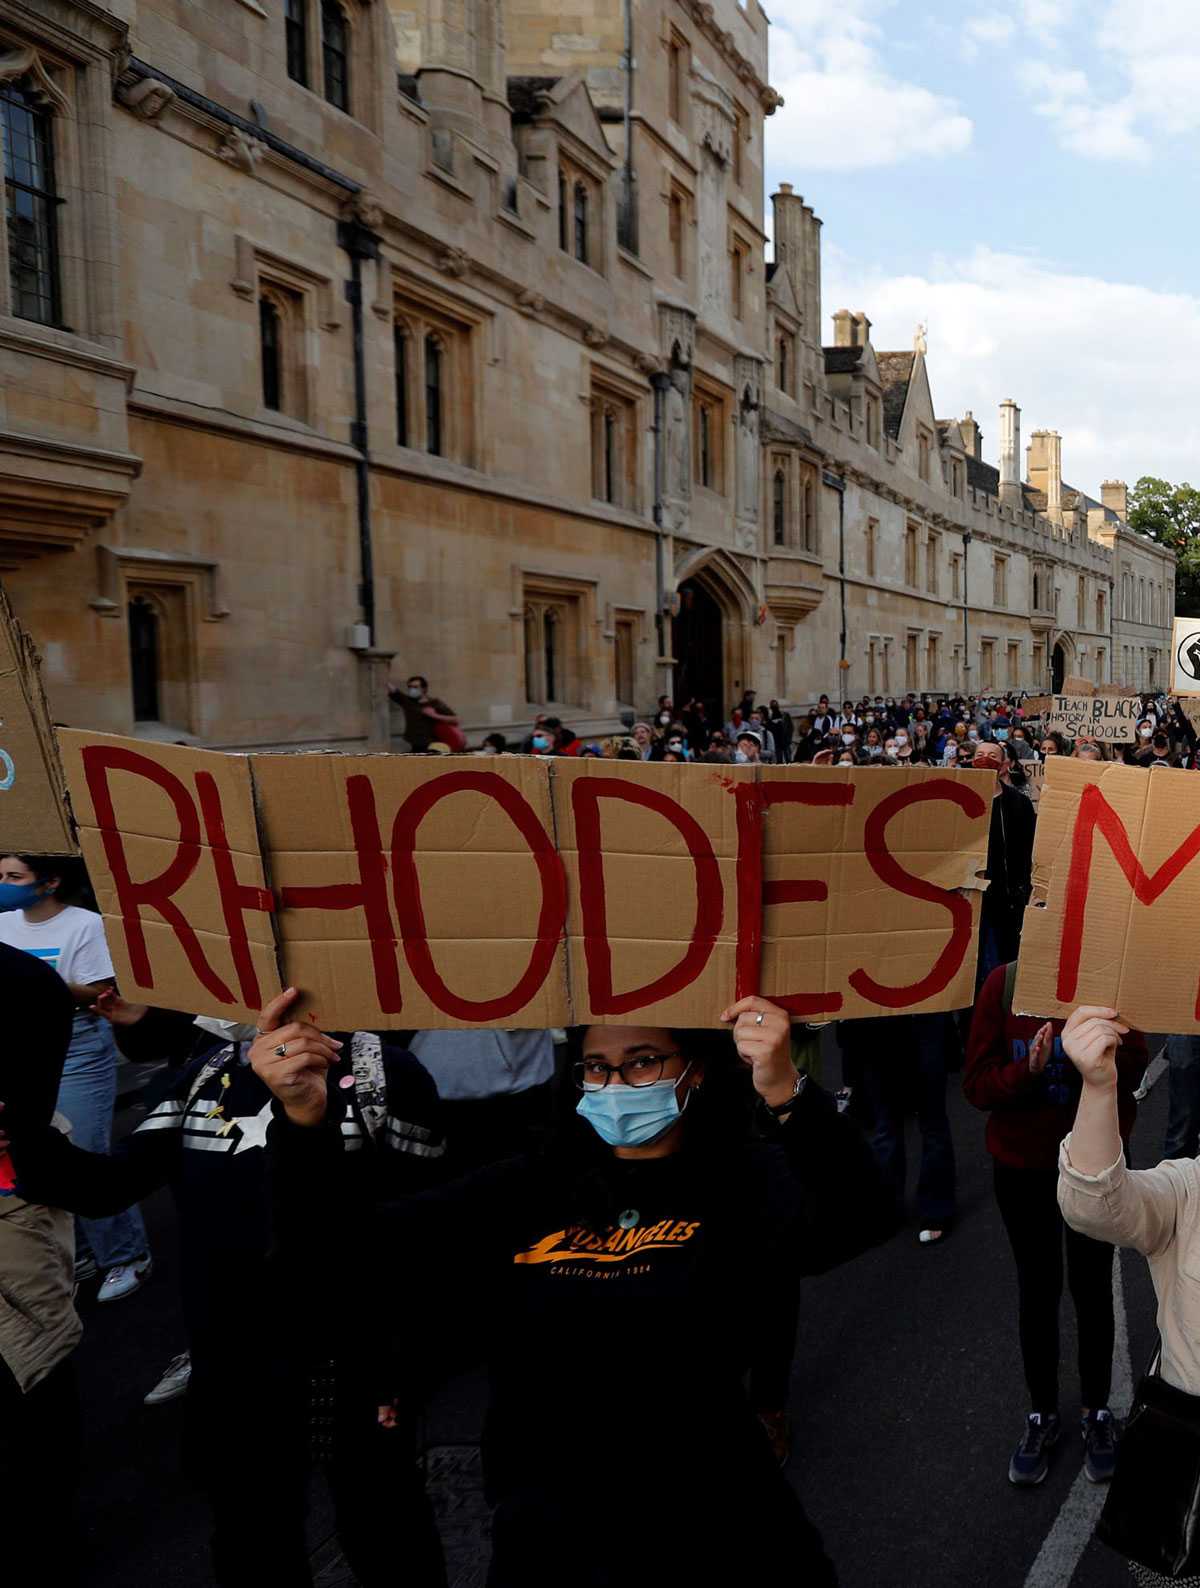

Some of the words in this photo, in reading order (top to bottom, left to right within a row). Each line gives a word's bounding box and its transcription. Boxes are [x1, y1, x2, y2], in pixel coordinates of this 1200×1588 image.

[1055, 698, 1088, 712] TEACH
[1092, 701, 1138, 719] BLACK
[1051, 711, 1085, 723] HISTORY
[1066, 723, 1129, 738] SCHOOLS
[83, 745, 987, 1021] RHODES
[550, 1265, 621, 1279] CALIFORNIA
